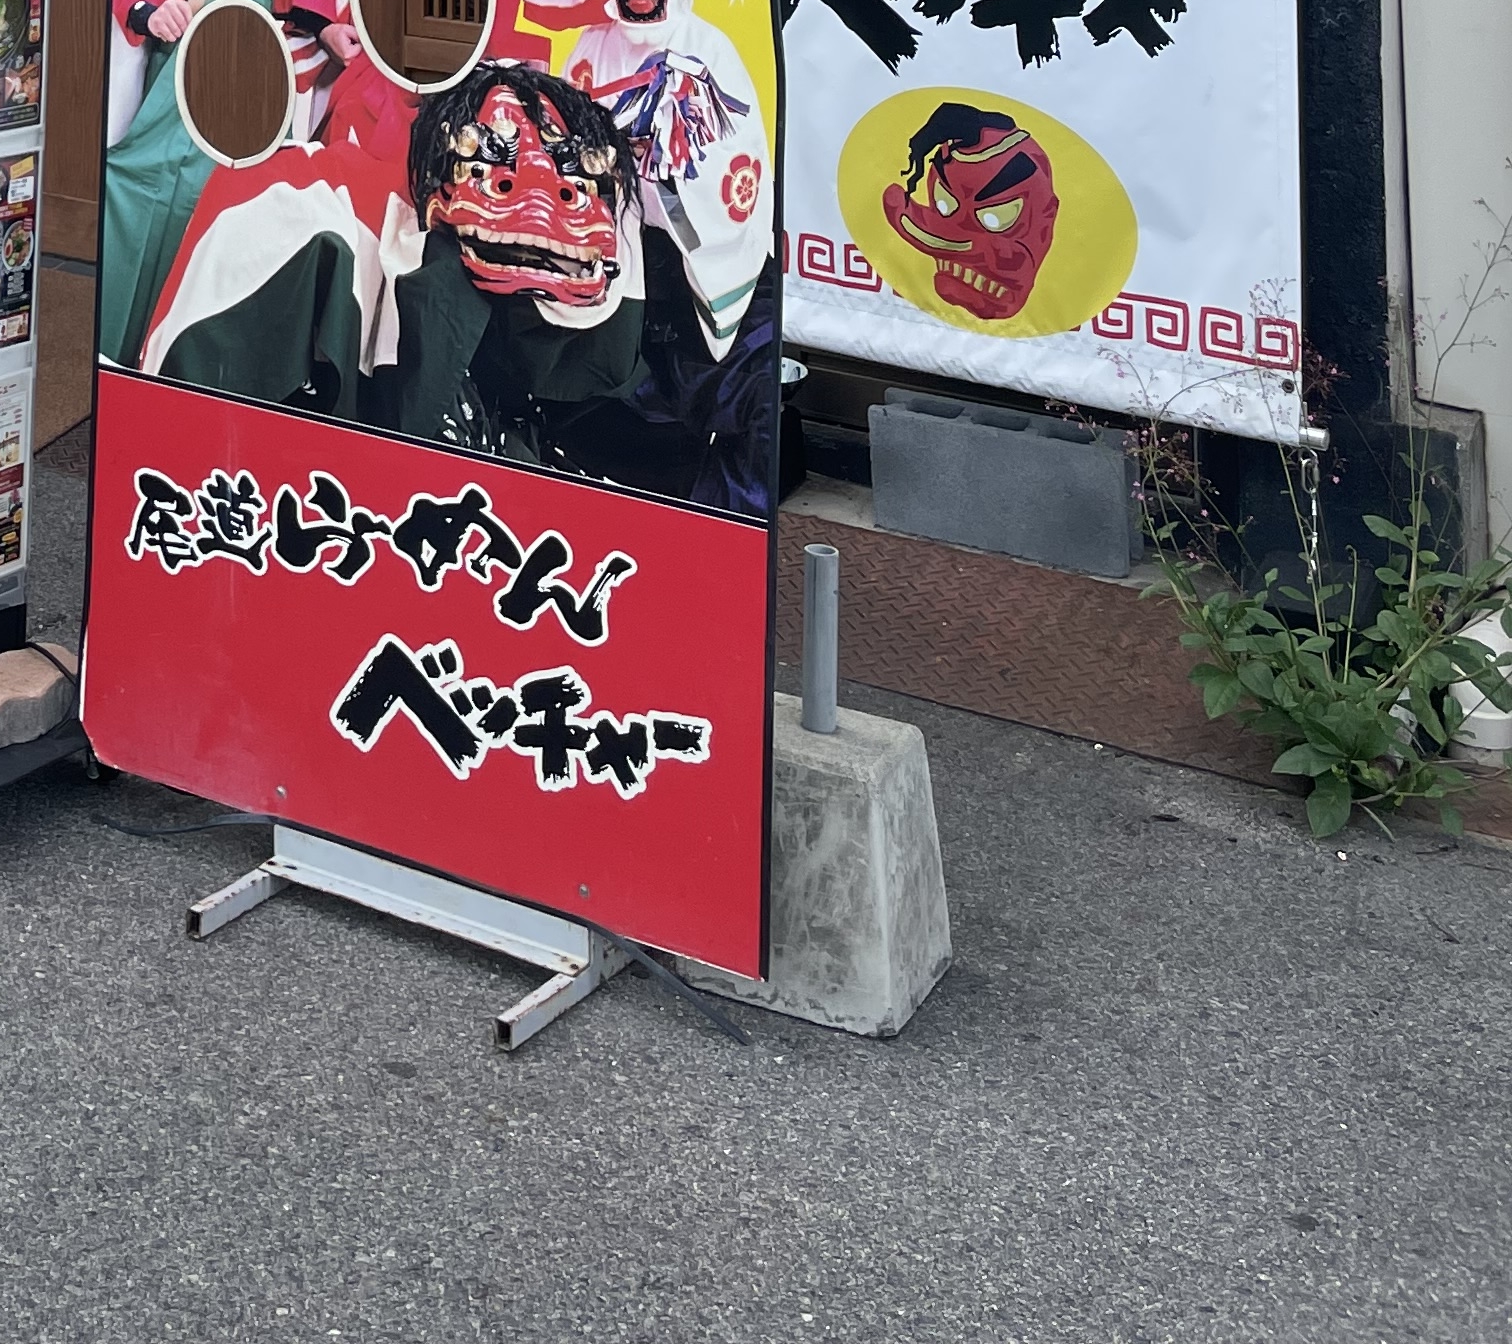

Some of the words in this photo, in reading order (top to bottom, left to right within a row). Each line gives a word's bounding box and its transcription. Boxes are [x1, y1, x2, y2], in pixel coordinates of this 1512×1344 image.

[330, 632, 712, 800] ベッチャー
